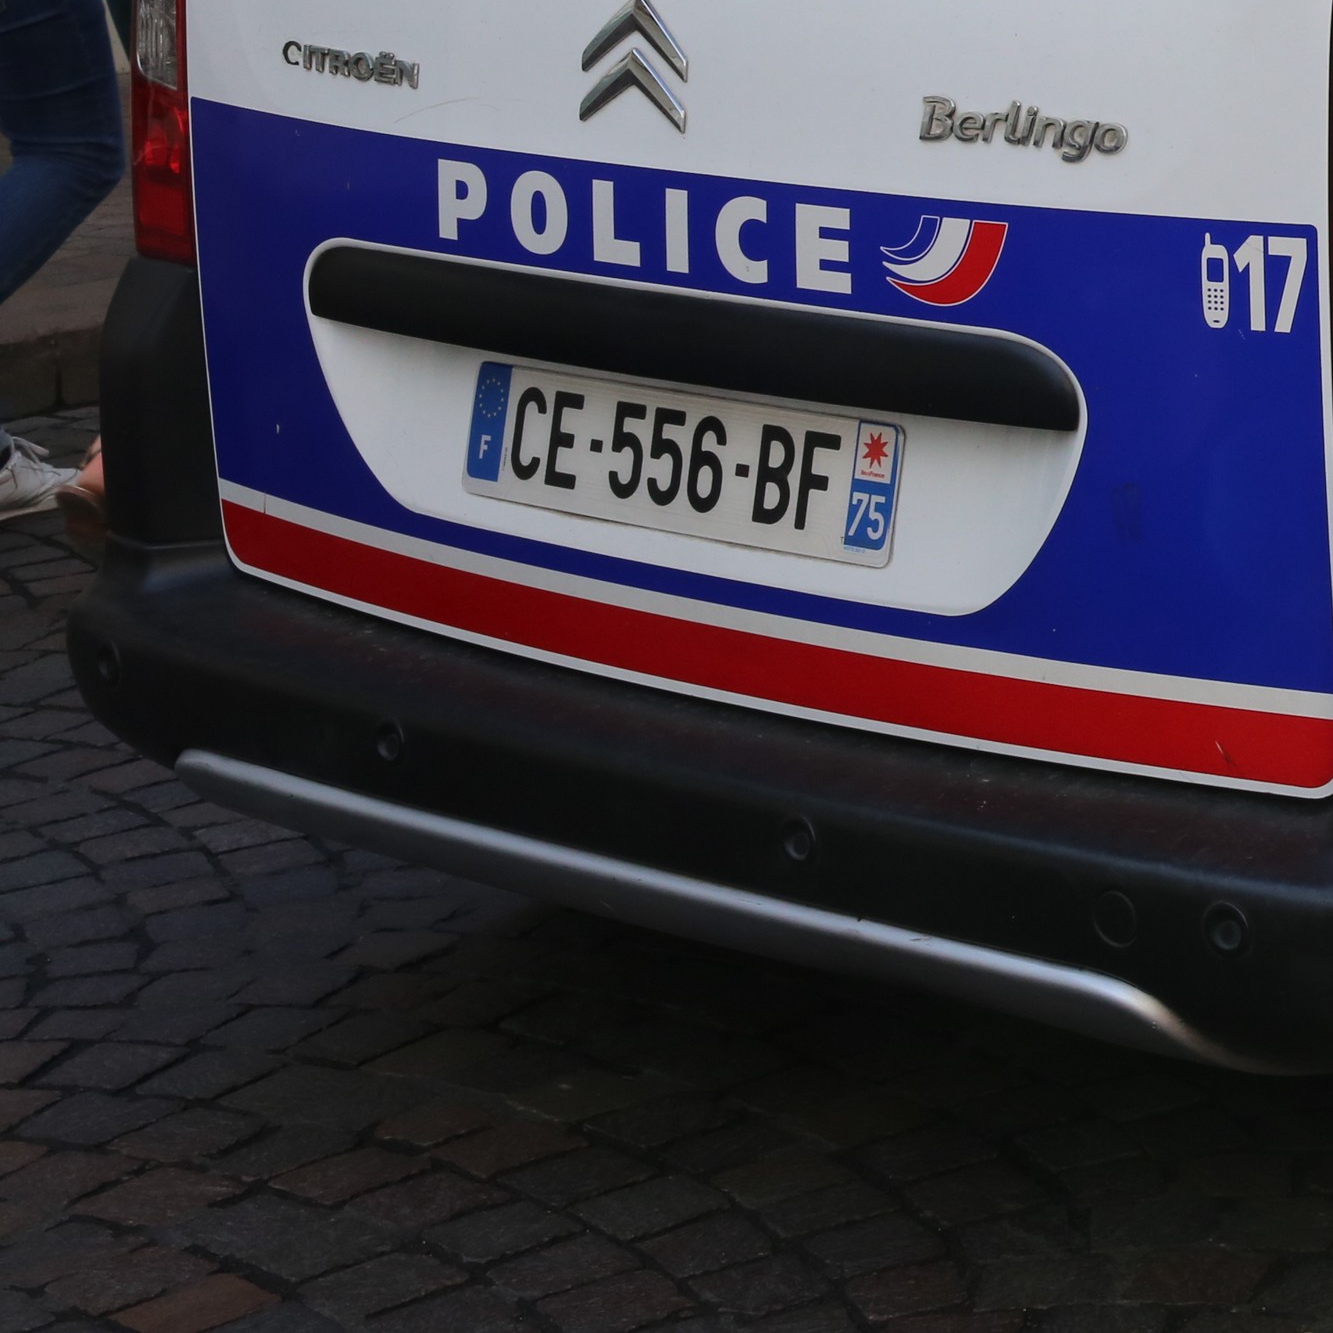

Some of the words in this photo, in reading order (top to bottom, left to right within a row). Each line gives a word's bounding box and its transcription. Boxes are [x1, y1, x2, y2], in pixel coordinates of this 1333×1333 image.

[281, 39, 421, 90] CITROËN
[918, 94, 1130, 164] Berlingo
[437, 158, 853, 295] POLICE
[1232, 234, 1309, 334] 17
[478, 433, 492, 459] F
[510, 385, 843, 532] CE-556-BF
[847, 491, 887, 541] 75
